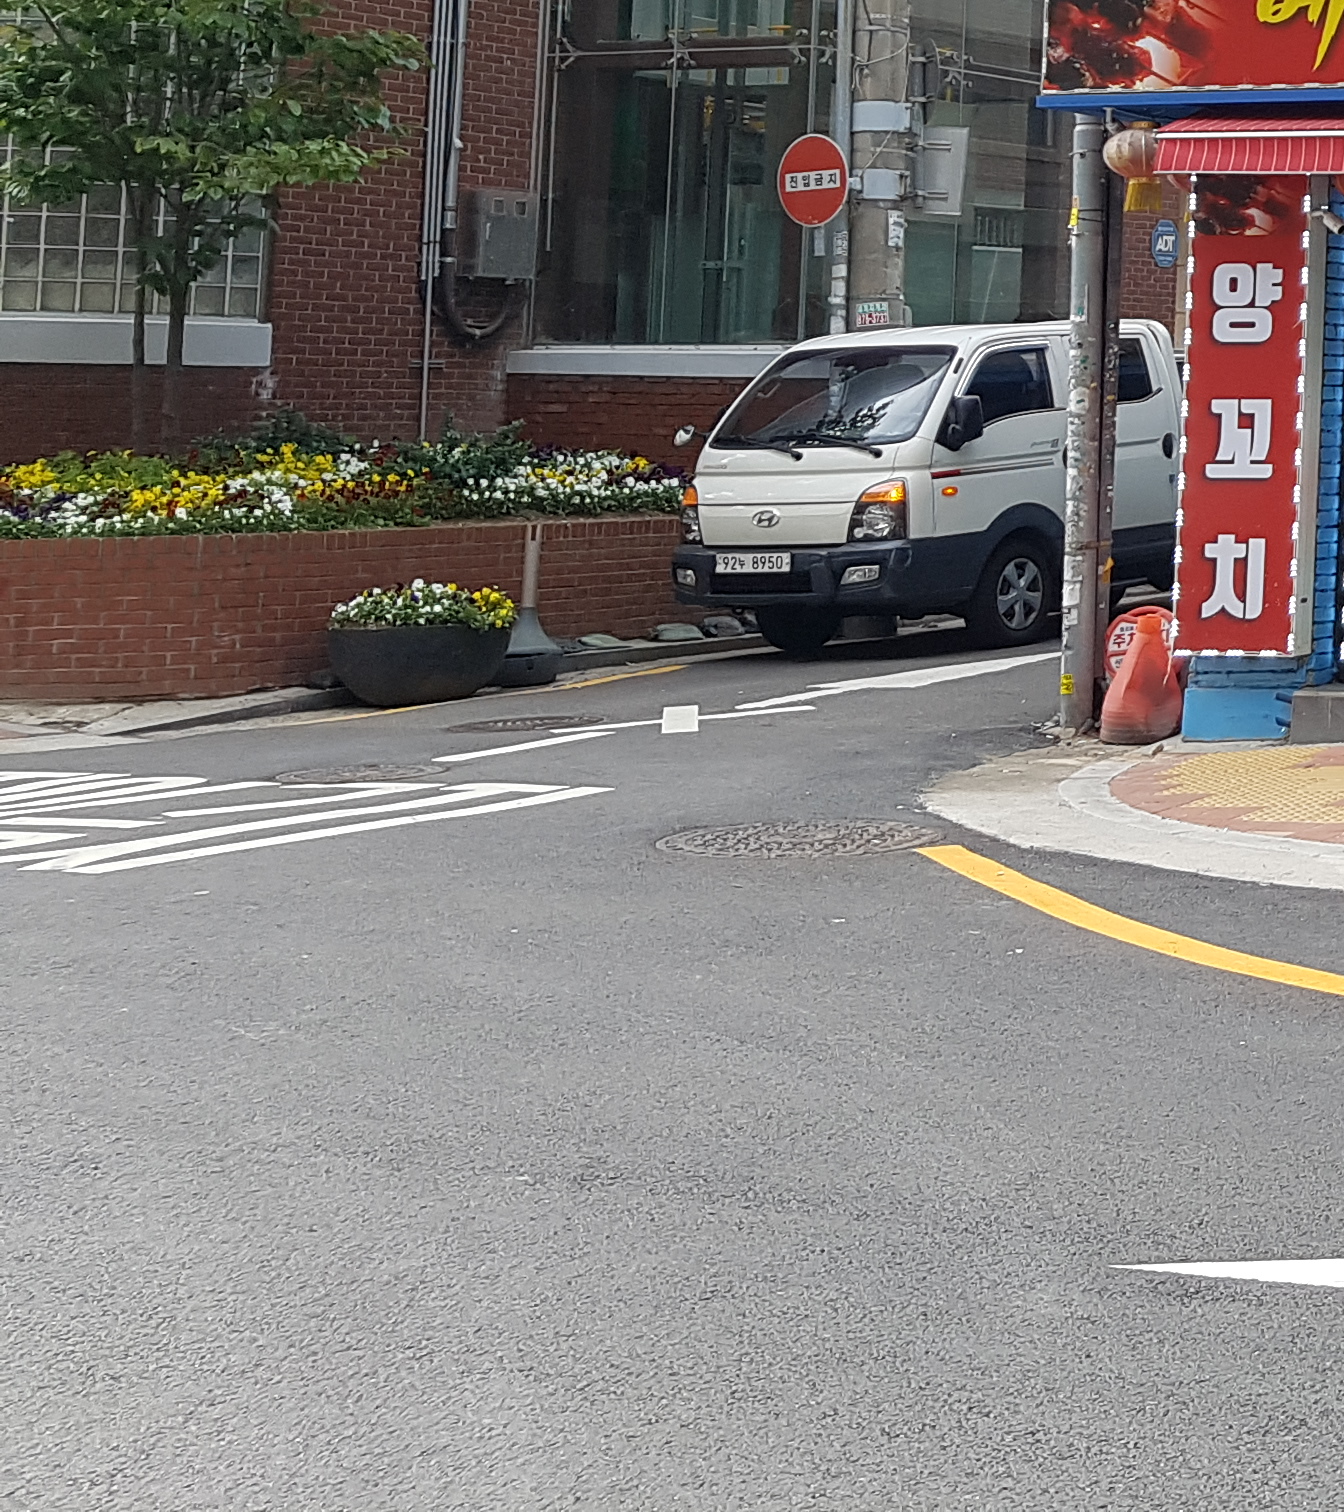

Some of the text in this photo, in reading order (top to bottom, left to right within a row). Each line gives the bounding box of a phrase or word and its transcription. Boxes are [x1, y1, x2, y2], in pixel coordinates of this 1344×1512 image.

[789, 172, 838, 189] 진입금지
[1155, 235, 1176, 252] ADT
[1200, 262, 1283, 620] 양꼬치
[722, 555, 784, 571] 92누 8950
